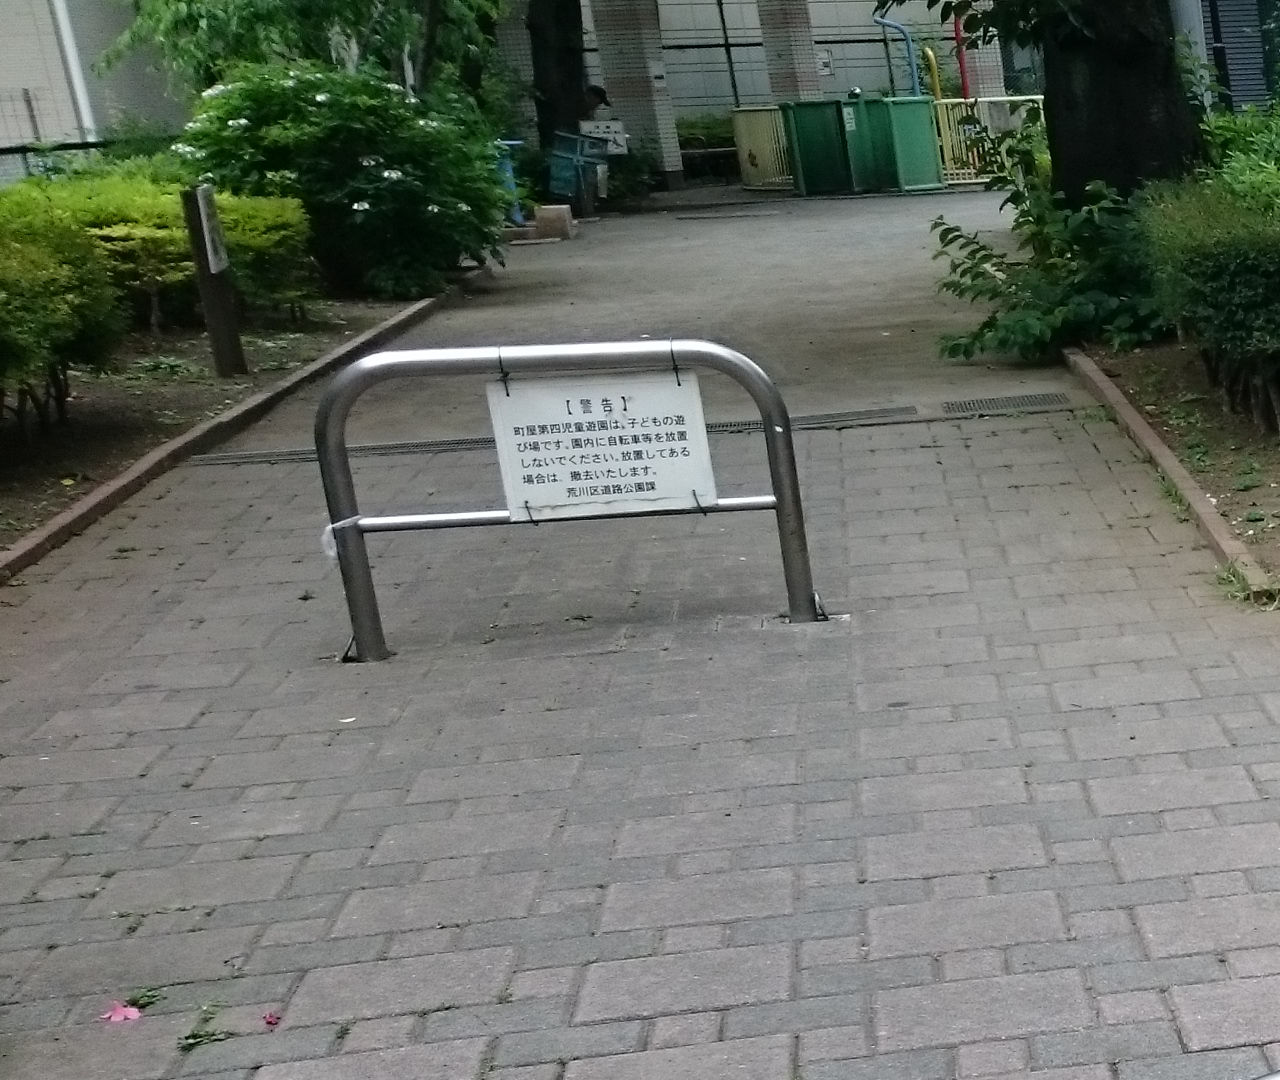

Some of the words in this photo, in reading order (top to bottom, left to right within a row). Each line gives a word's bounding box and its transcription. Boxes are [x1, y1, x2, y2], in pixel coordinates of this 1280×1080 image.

[513, 414, 686, 437] 町屋第四児童遊園は、子どもの遊
[516, 430, 689, 453] び場です。園内に自転車等を放置
[520, 446, 690, 469] しないでください。放置してある
[566, 481, 657, 498] 荒川区道路公園課
